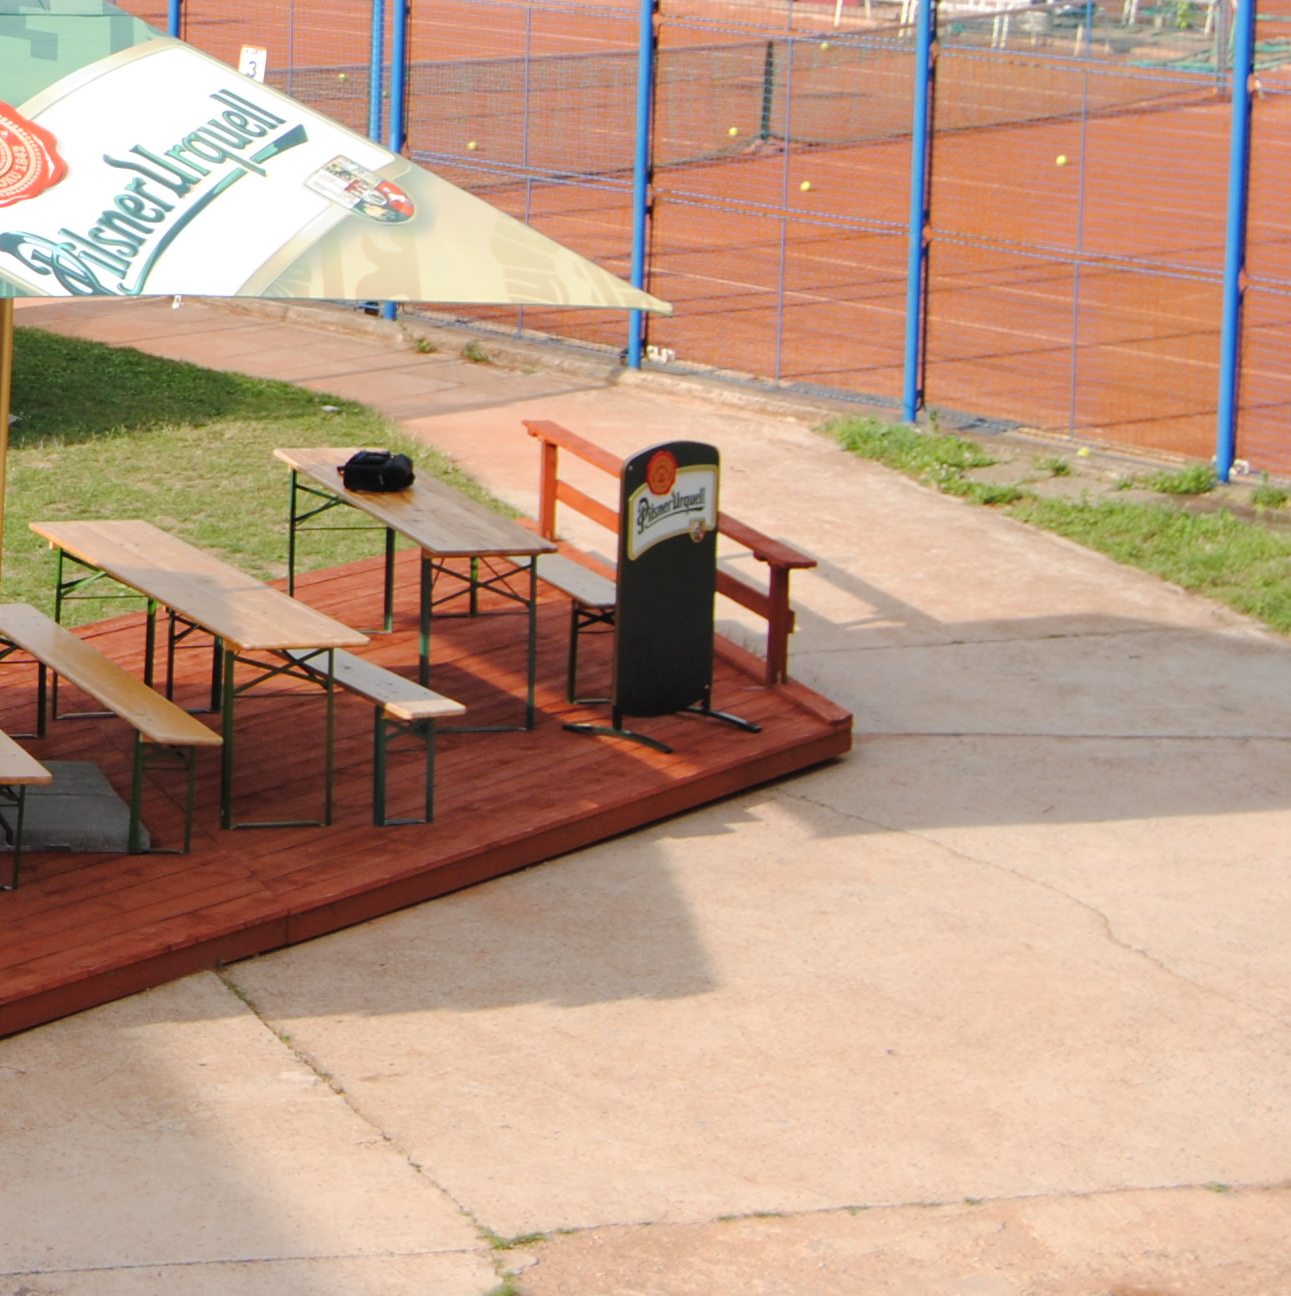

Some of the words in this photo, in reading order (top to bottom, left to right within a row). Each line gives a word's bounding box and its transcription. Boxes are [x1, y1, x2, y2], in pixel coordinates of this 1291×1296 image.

[248, 60, 257, 79] 3
[12, 144, 28, 172] 1842
[103, 89, 287, 198] Urquell
[636, 497, 674, 536] Pilsner
[671, 487, 707, 515] Urquell
